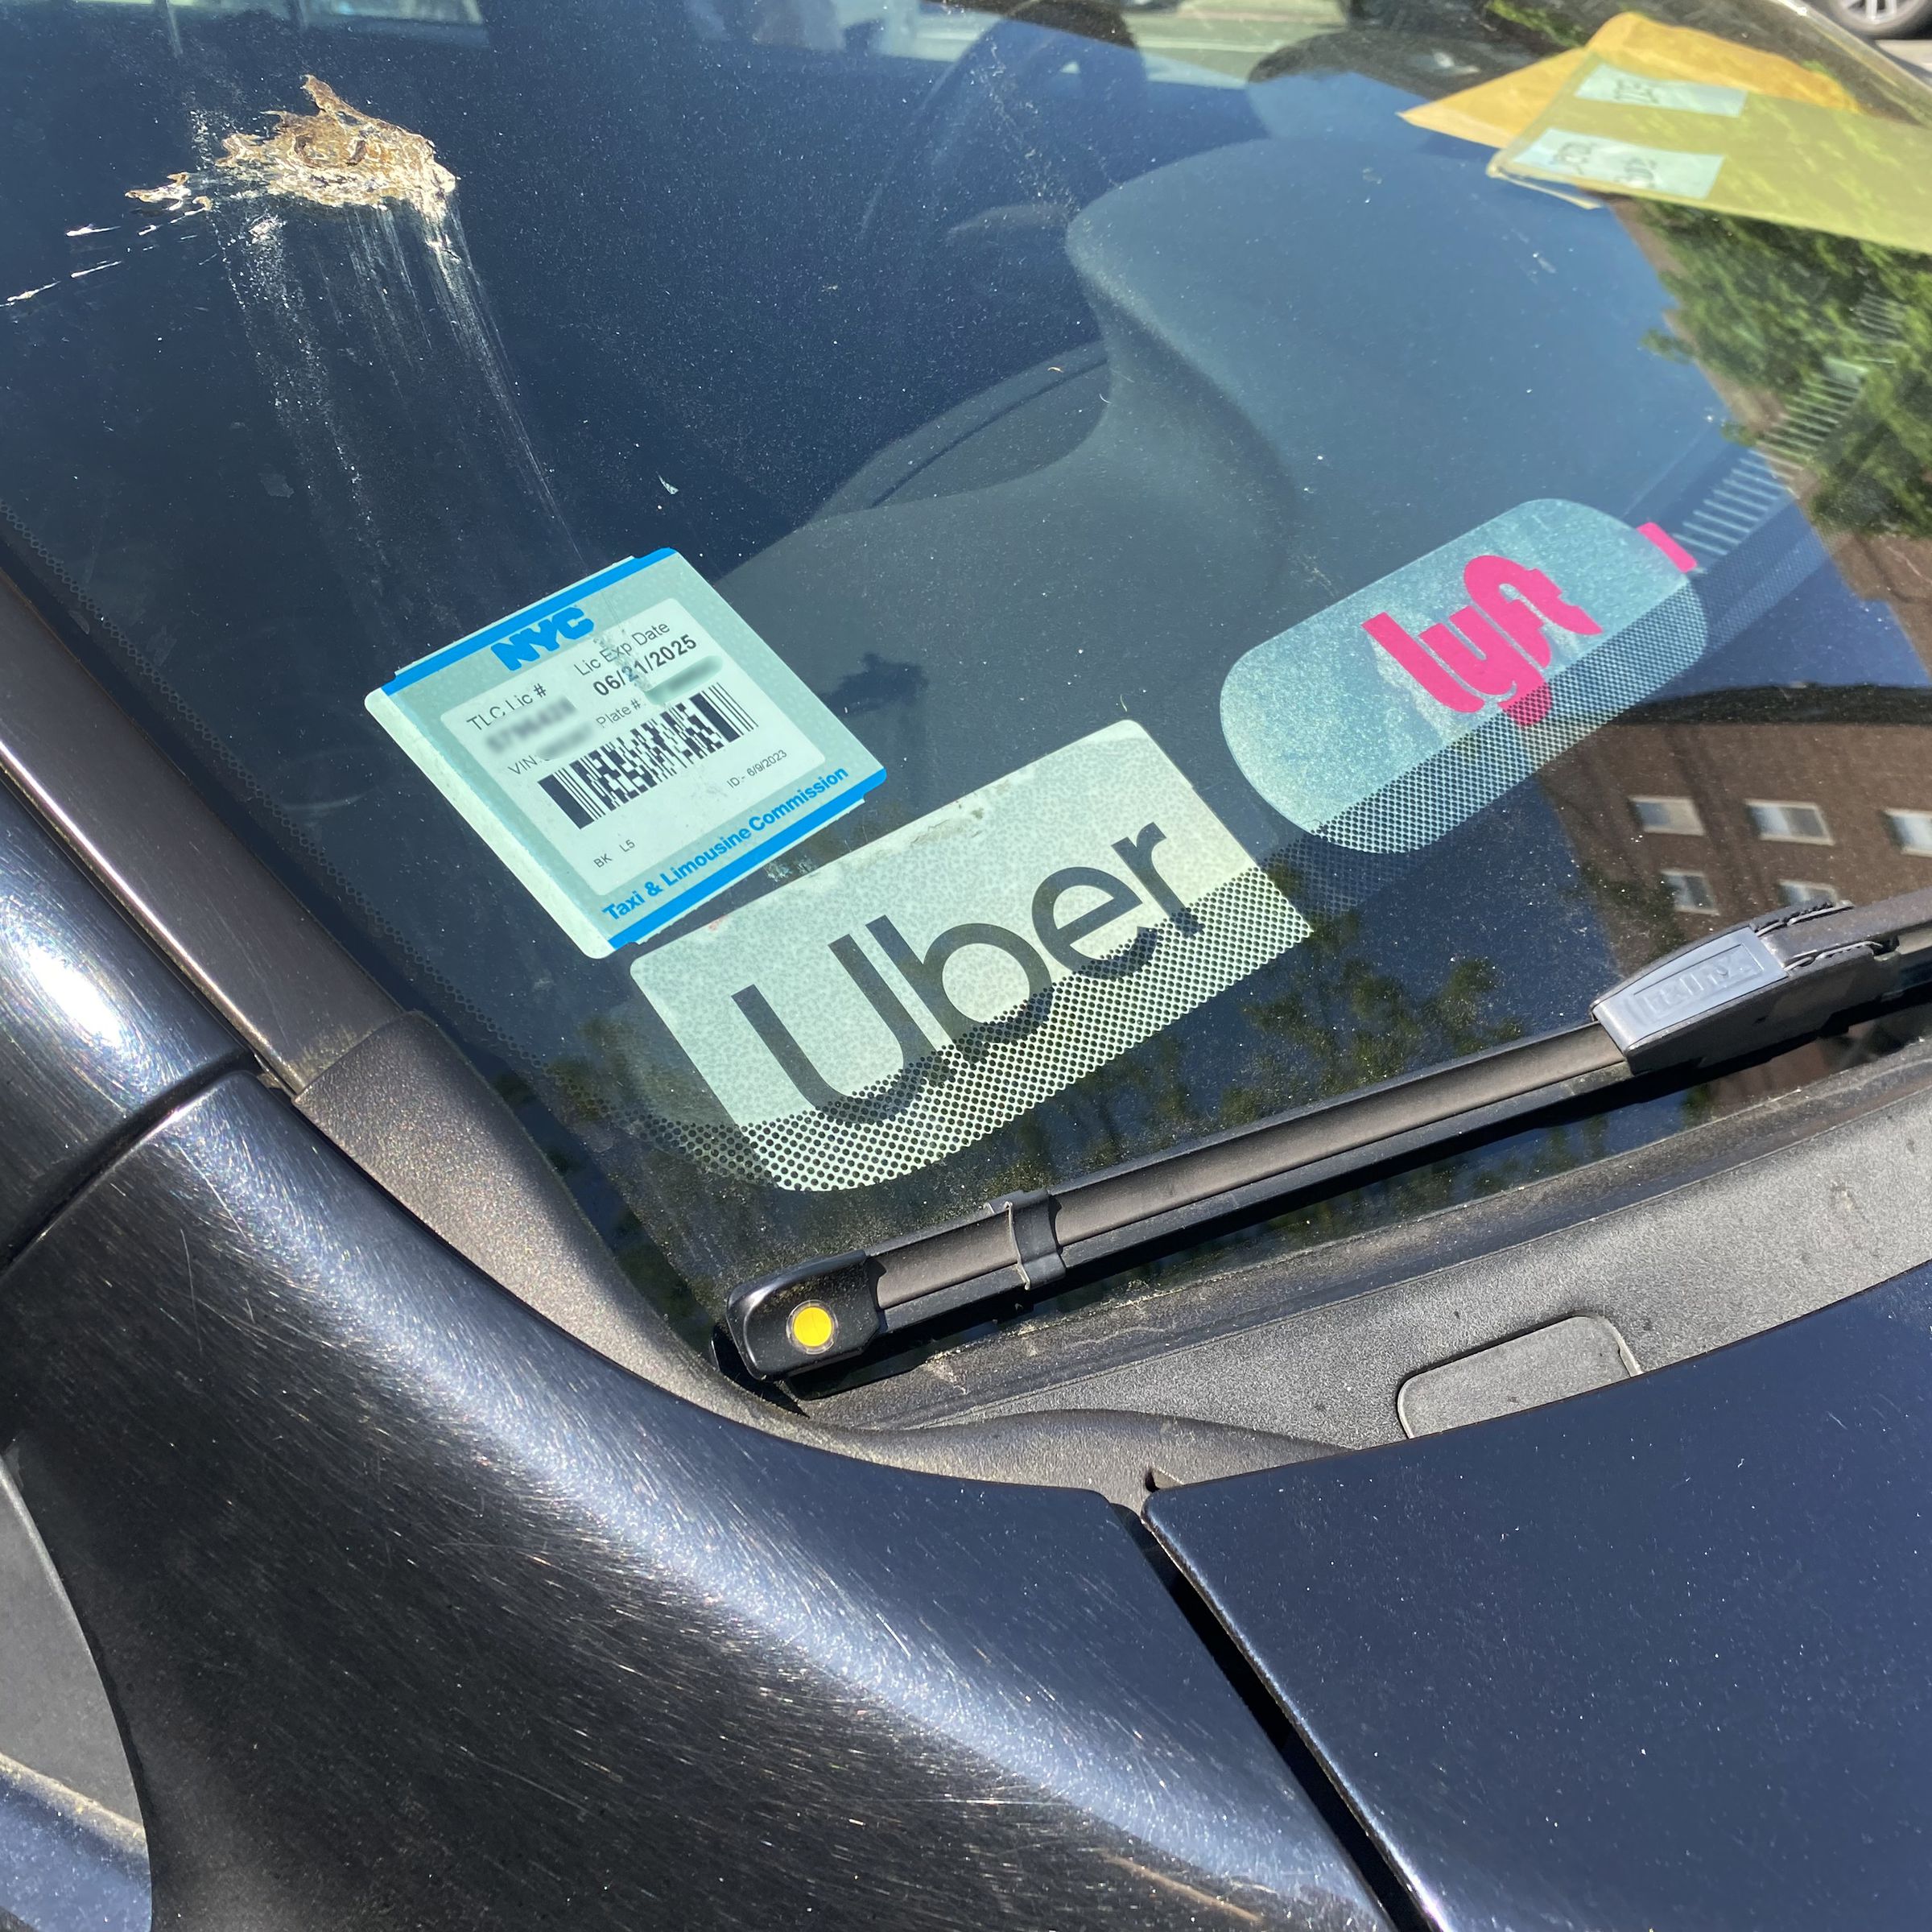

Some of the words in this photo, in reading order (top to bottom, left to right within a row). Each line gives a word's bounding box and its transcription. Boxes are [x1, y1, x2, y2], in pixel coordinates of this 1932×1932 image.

[490, 606, 594, 671] NYC
[574, 658, 601, 676] Lic
[600, 641, 633, 663] Exp
[631, 621, 670, 646] Date
[592, 634, 697, 696] 06/21/2025
[466, 705, 506, 732] TLC
[505, 692, 534, 712] Lic
[533, 683, 547, 698] #
[596, 708, 632, 729] Plate
[746, 749, 787, 778] 6/9/2023
[593, 853, 613, 868] BK
[619, 839, 636, 853] L5
[601, 890, 646, 920] Taxi
[644, 881, 663, 898] &
[659, 828, 753, 886] Limousine
[748, 766, 849, 832] Commission
[730, 821, 1203, 1127] Uber
